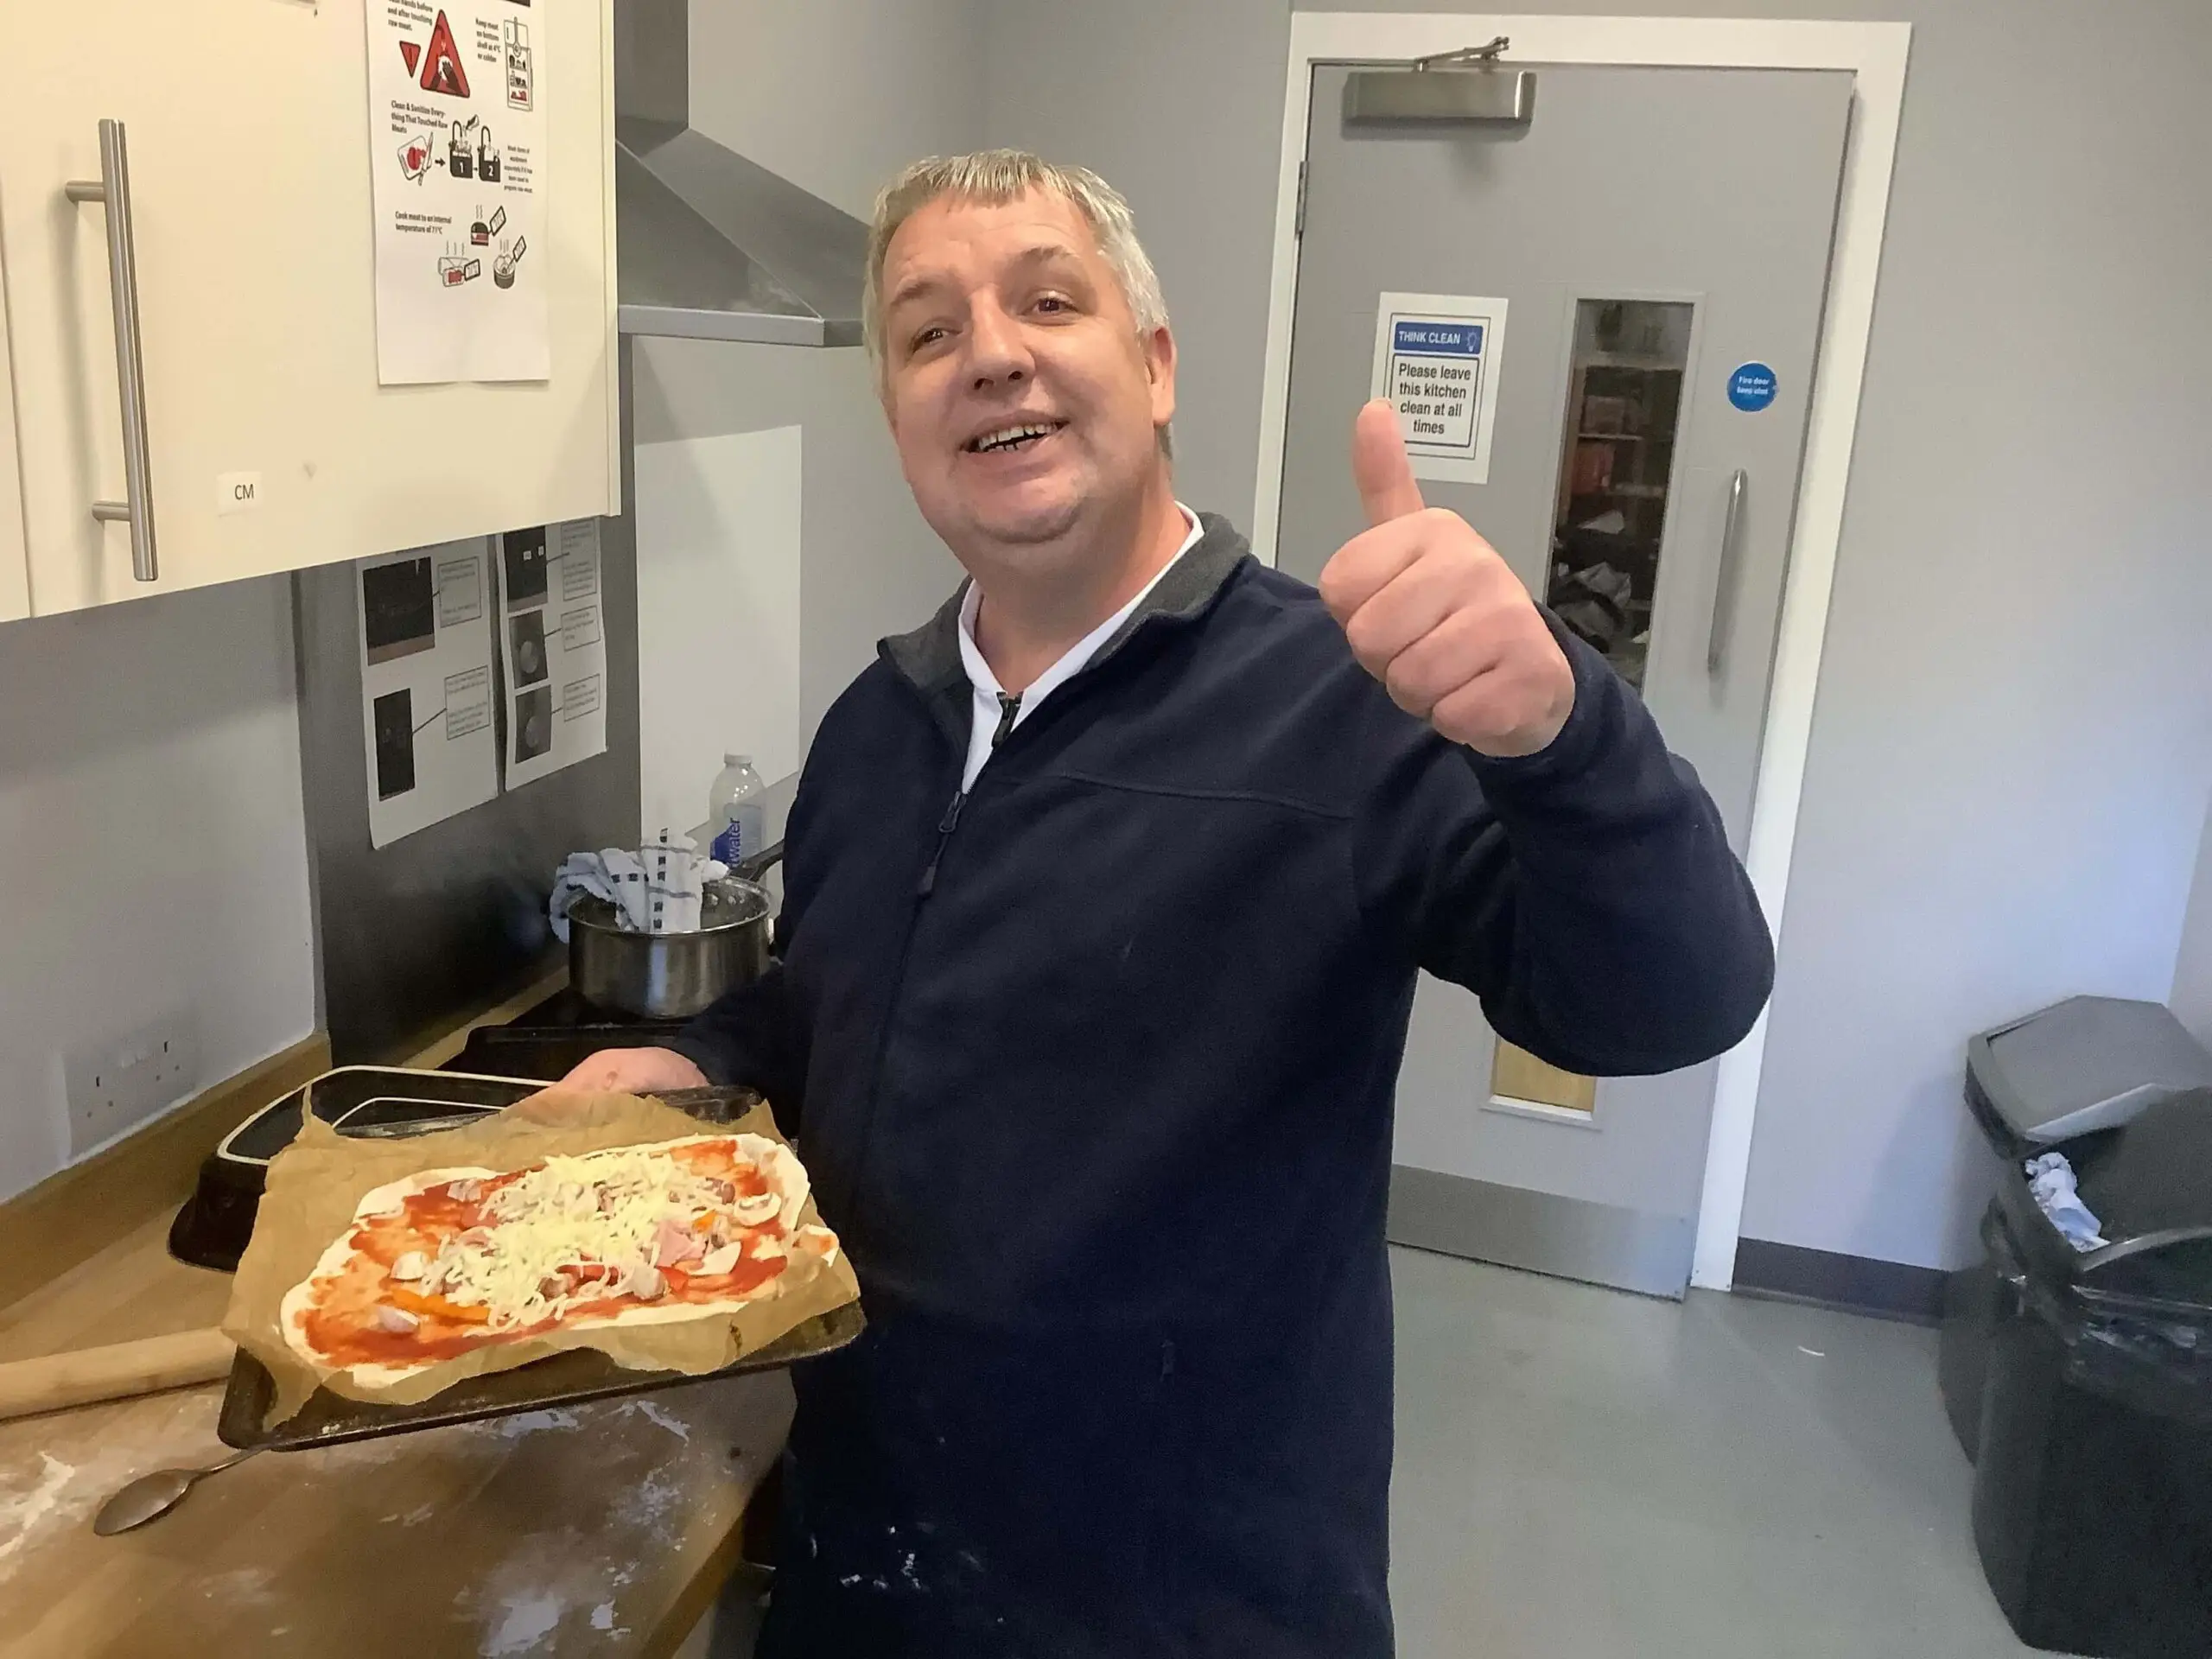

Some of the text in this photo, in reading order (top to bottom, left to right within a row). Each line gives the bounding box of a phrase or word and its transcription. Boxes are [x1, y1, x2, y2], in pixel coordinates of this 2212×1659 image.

[391, 99, 405, 110] Clean
[391, 112, 404, 123] thing
[405, 114, 416, 124] That
[417, 117, 437, 127] Touched
[460, 162, 464, 173] 1
[488, 165, 493, 176] 2
[396, 211, 407, 219] Cook
[396, 224, 425, 233] temperature
[1398, 330, 1461, 345] THINK CLEAN
[1399, 363, 1471, 381] Please leave
[1738, 376, 1770, 385] Fire door
[1399, 382, 1466, 399] this kitchen
[1400, 400, 1462, 417] clean at all
[1413, 419, 1445, 435] times
[234, 483, 254, 500] CM
